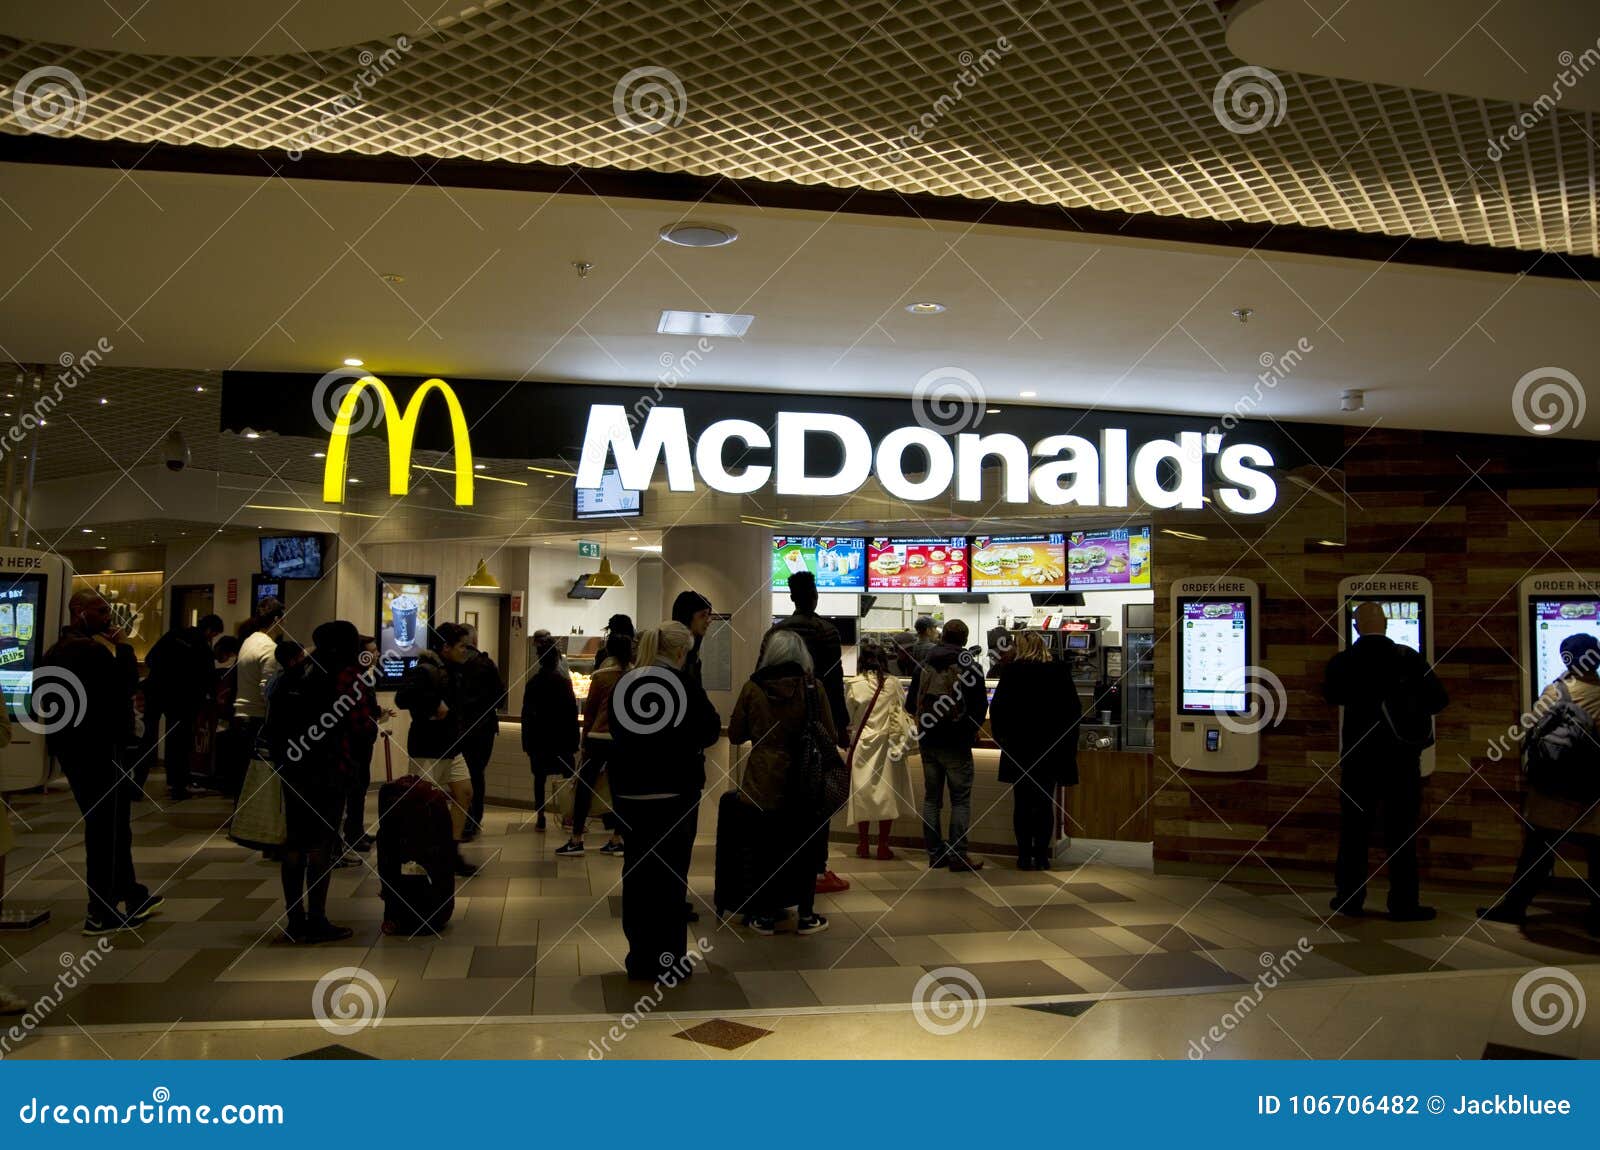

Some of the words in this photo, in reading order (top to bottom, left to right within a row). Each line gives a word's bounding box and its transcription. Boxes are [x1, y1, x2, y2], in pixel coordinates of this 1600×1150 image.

[575, 403, 1278, 515] McDonald's
[8, 557, 42, 568] HERE
[1182, 583, 1216, 592] ORDER
[1218, 583, 1246, 592] HERE
[1350, 582, 1386, 591] ORDER
[1389, 581, 1420, 591] HERE
[1534, 581, 1575, 591] ORDER
